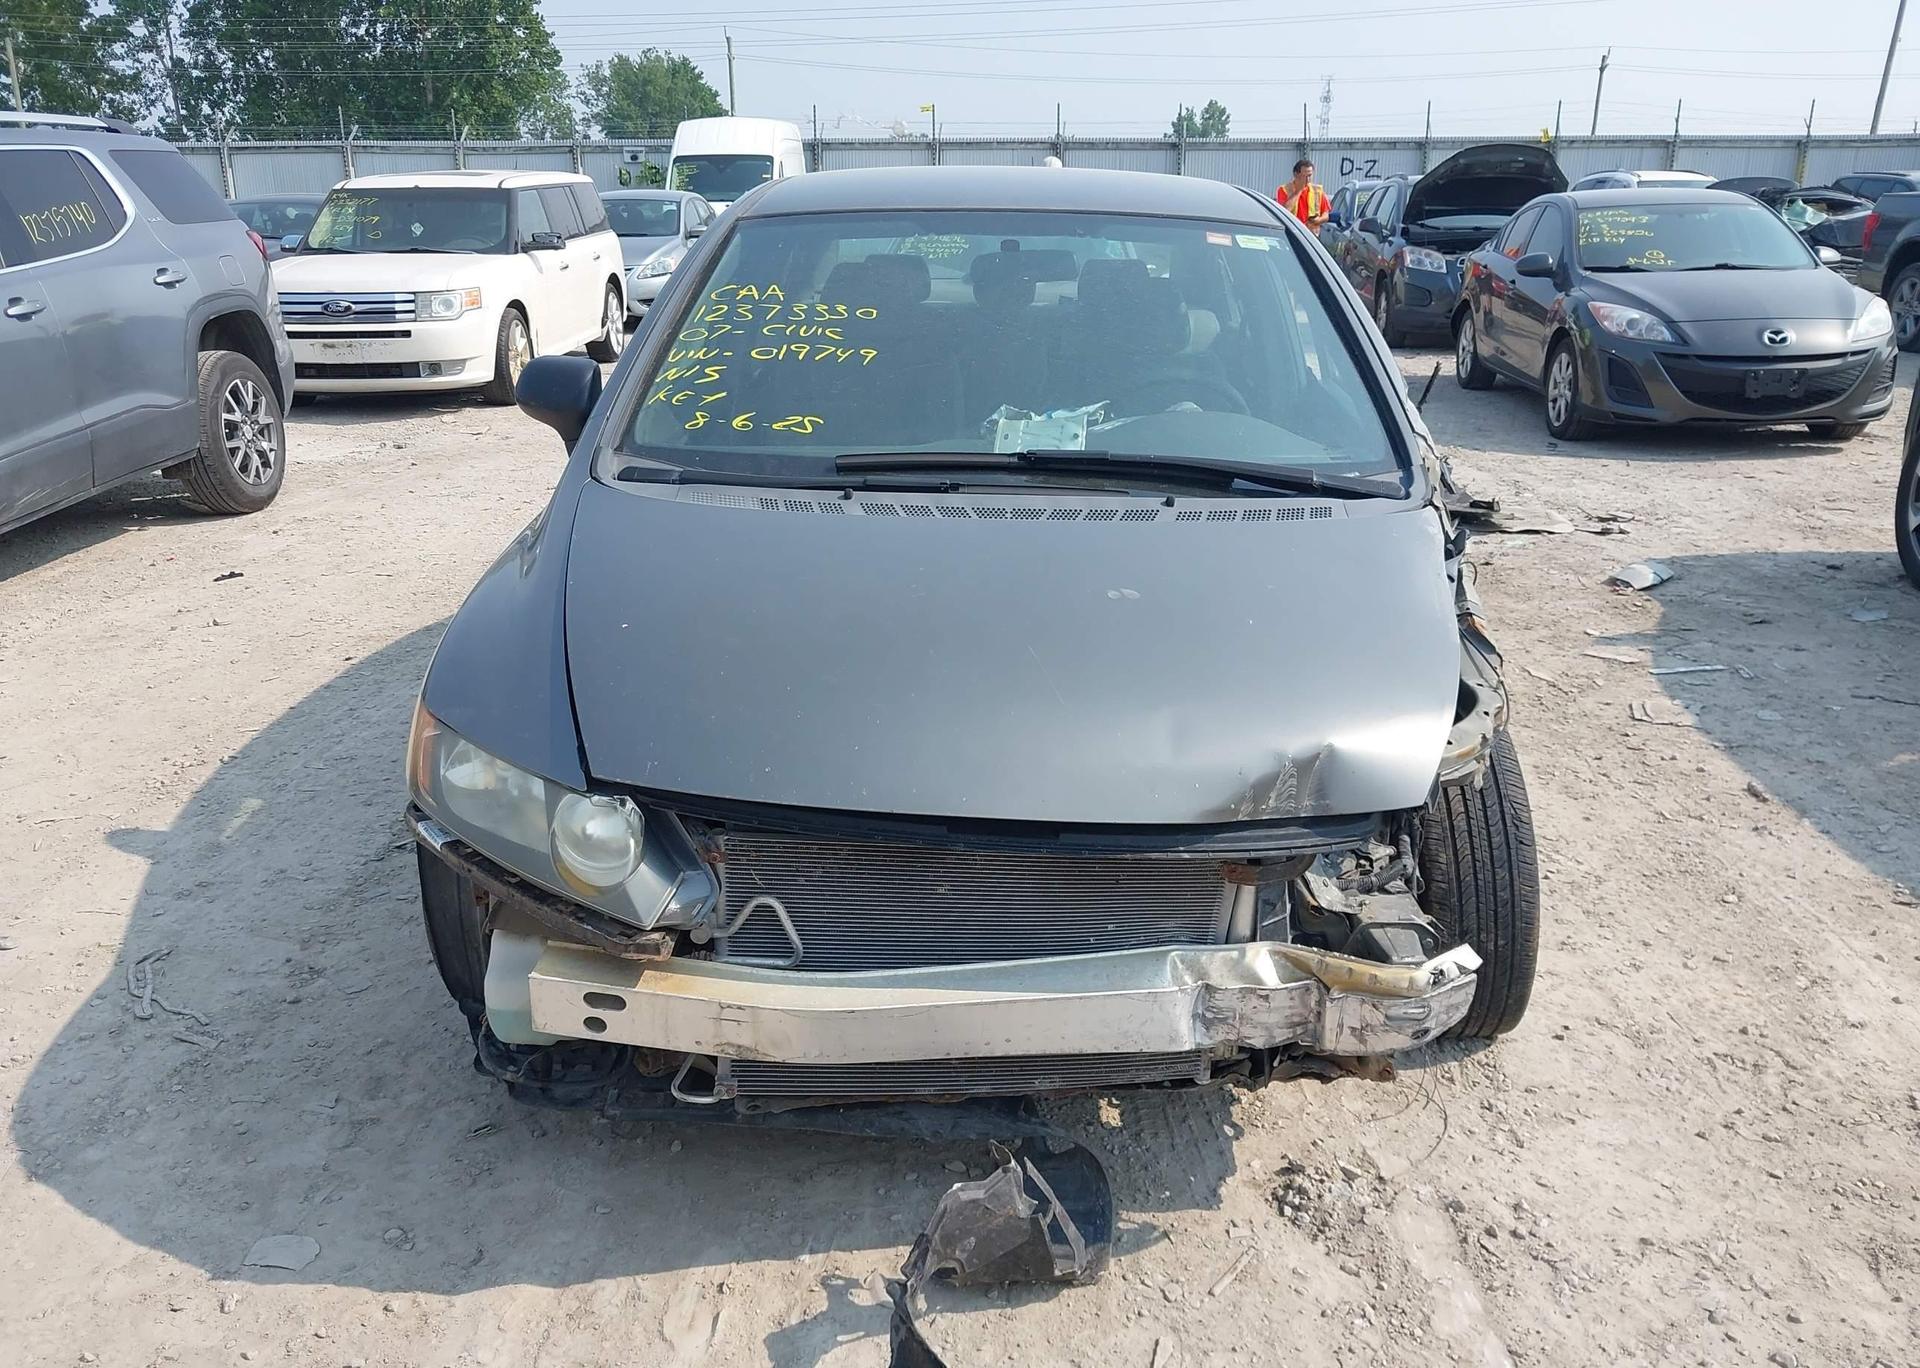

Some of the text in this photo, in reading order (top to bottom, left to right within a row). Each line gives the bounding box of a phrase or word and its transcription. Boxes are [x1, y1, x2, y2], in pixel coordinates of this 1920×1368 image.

[710, 285, 786, 301] CAA
[694, 304, 878, 322] 12373330
[750, 344, 878, 365] 019749
[648, 385, 728, 406] KEY
[684, 411, 824, 434] 8-6-25
